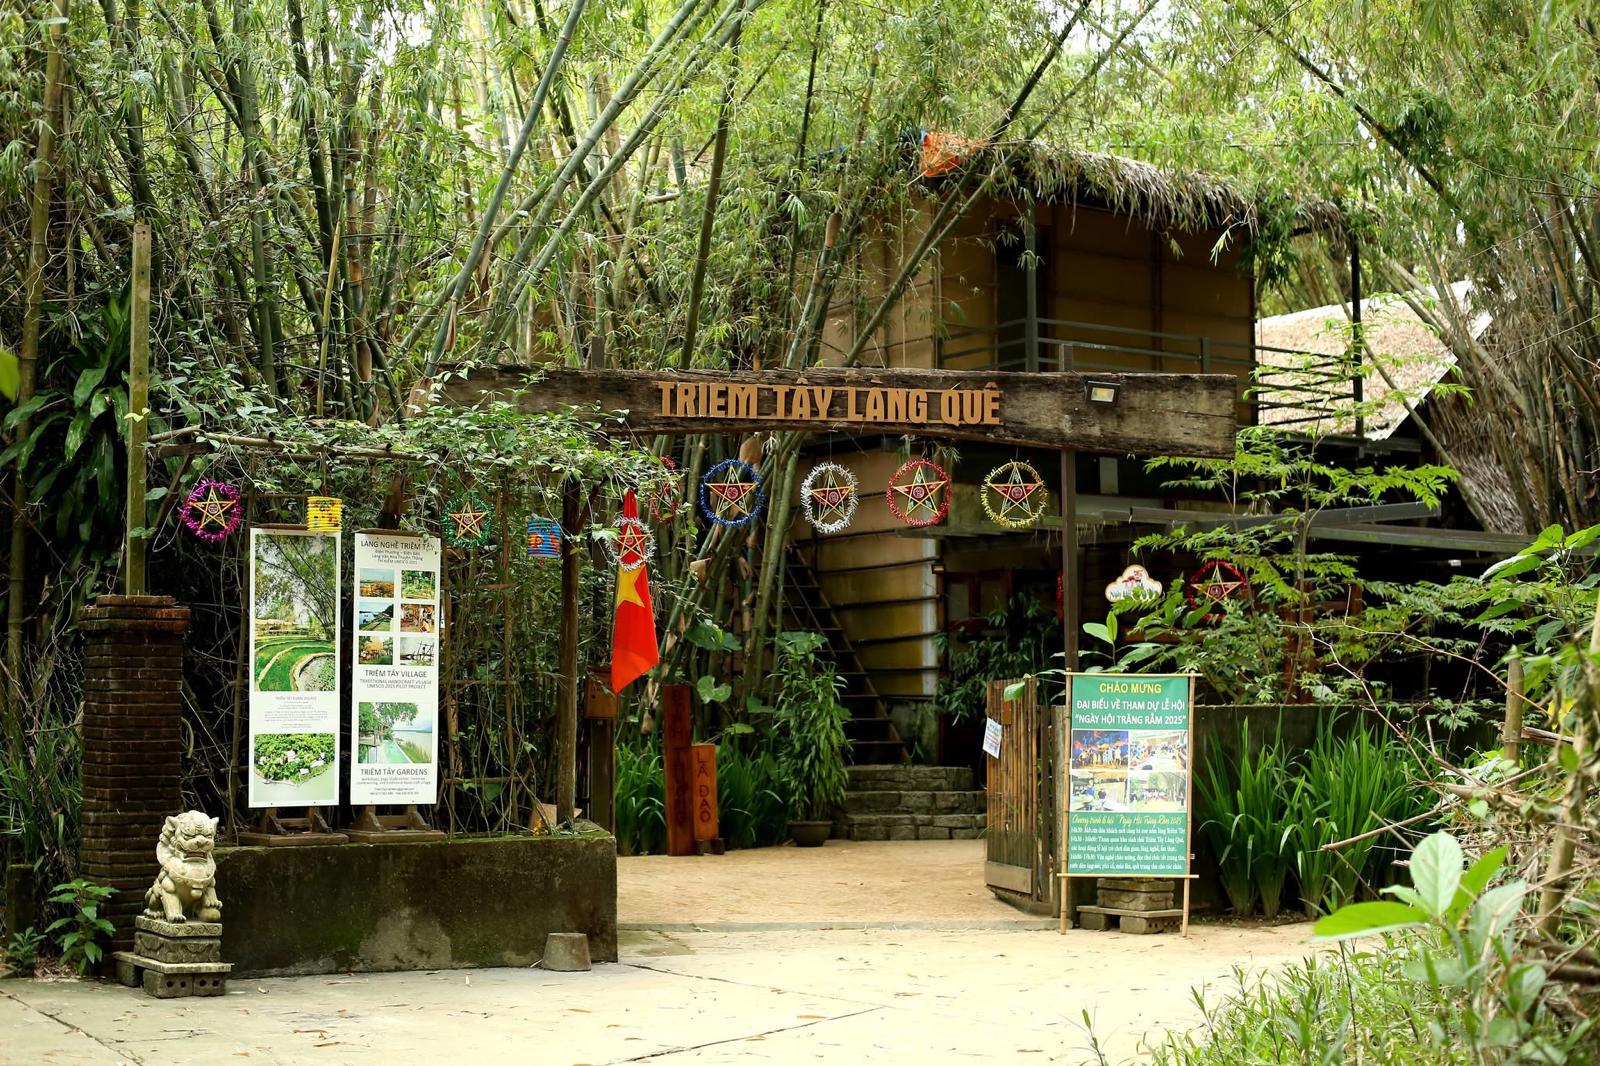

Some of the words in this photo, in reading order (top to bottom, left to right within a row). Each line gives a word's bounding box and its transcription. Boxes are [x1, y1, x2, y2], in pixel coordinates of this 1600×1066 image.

[773, 377, 833, 420] TÂY
[940, 381, 1001, 427] QUÊ
[1099, 681, 1129, 693] CHÀO
[1131, 681, 1162, 694] MỪNG
[1076, 700, 1090, 711] ĐẠI
[1091, 697, 1109, 709] BIỂU
[1110, 697, 1121, 710] VỀ
[1122, 701, 1145, 710] THAM
[1147, 700, 1159, 712] DỰ
[1161, 697, 1170, 710] LỄ
[1171, 699, 1185, 712] HỘI
[1101, 713, 1115, 725] HỘI
[396, 768, 428, 776] GARDENS
